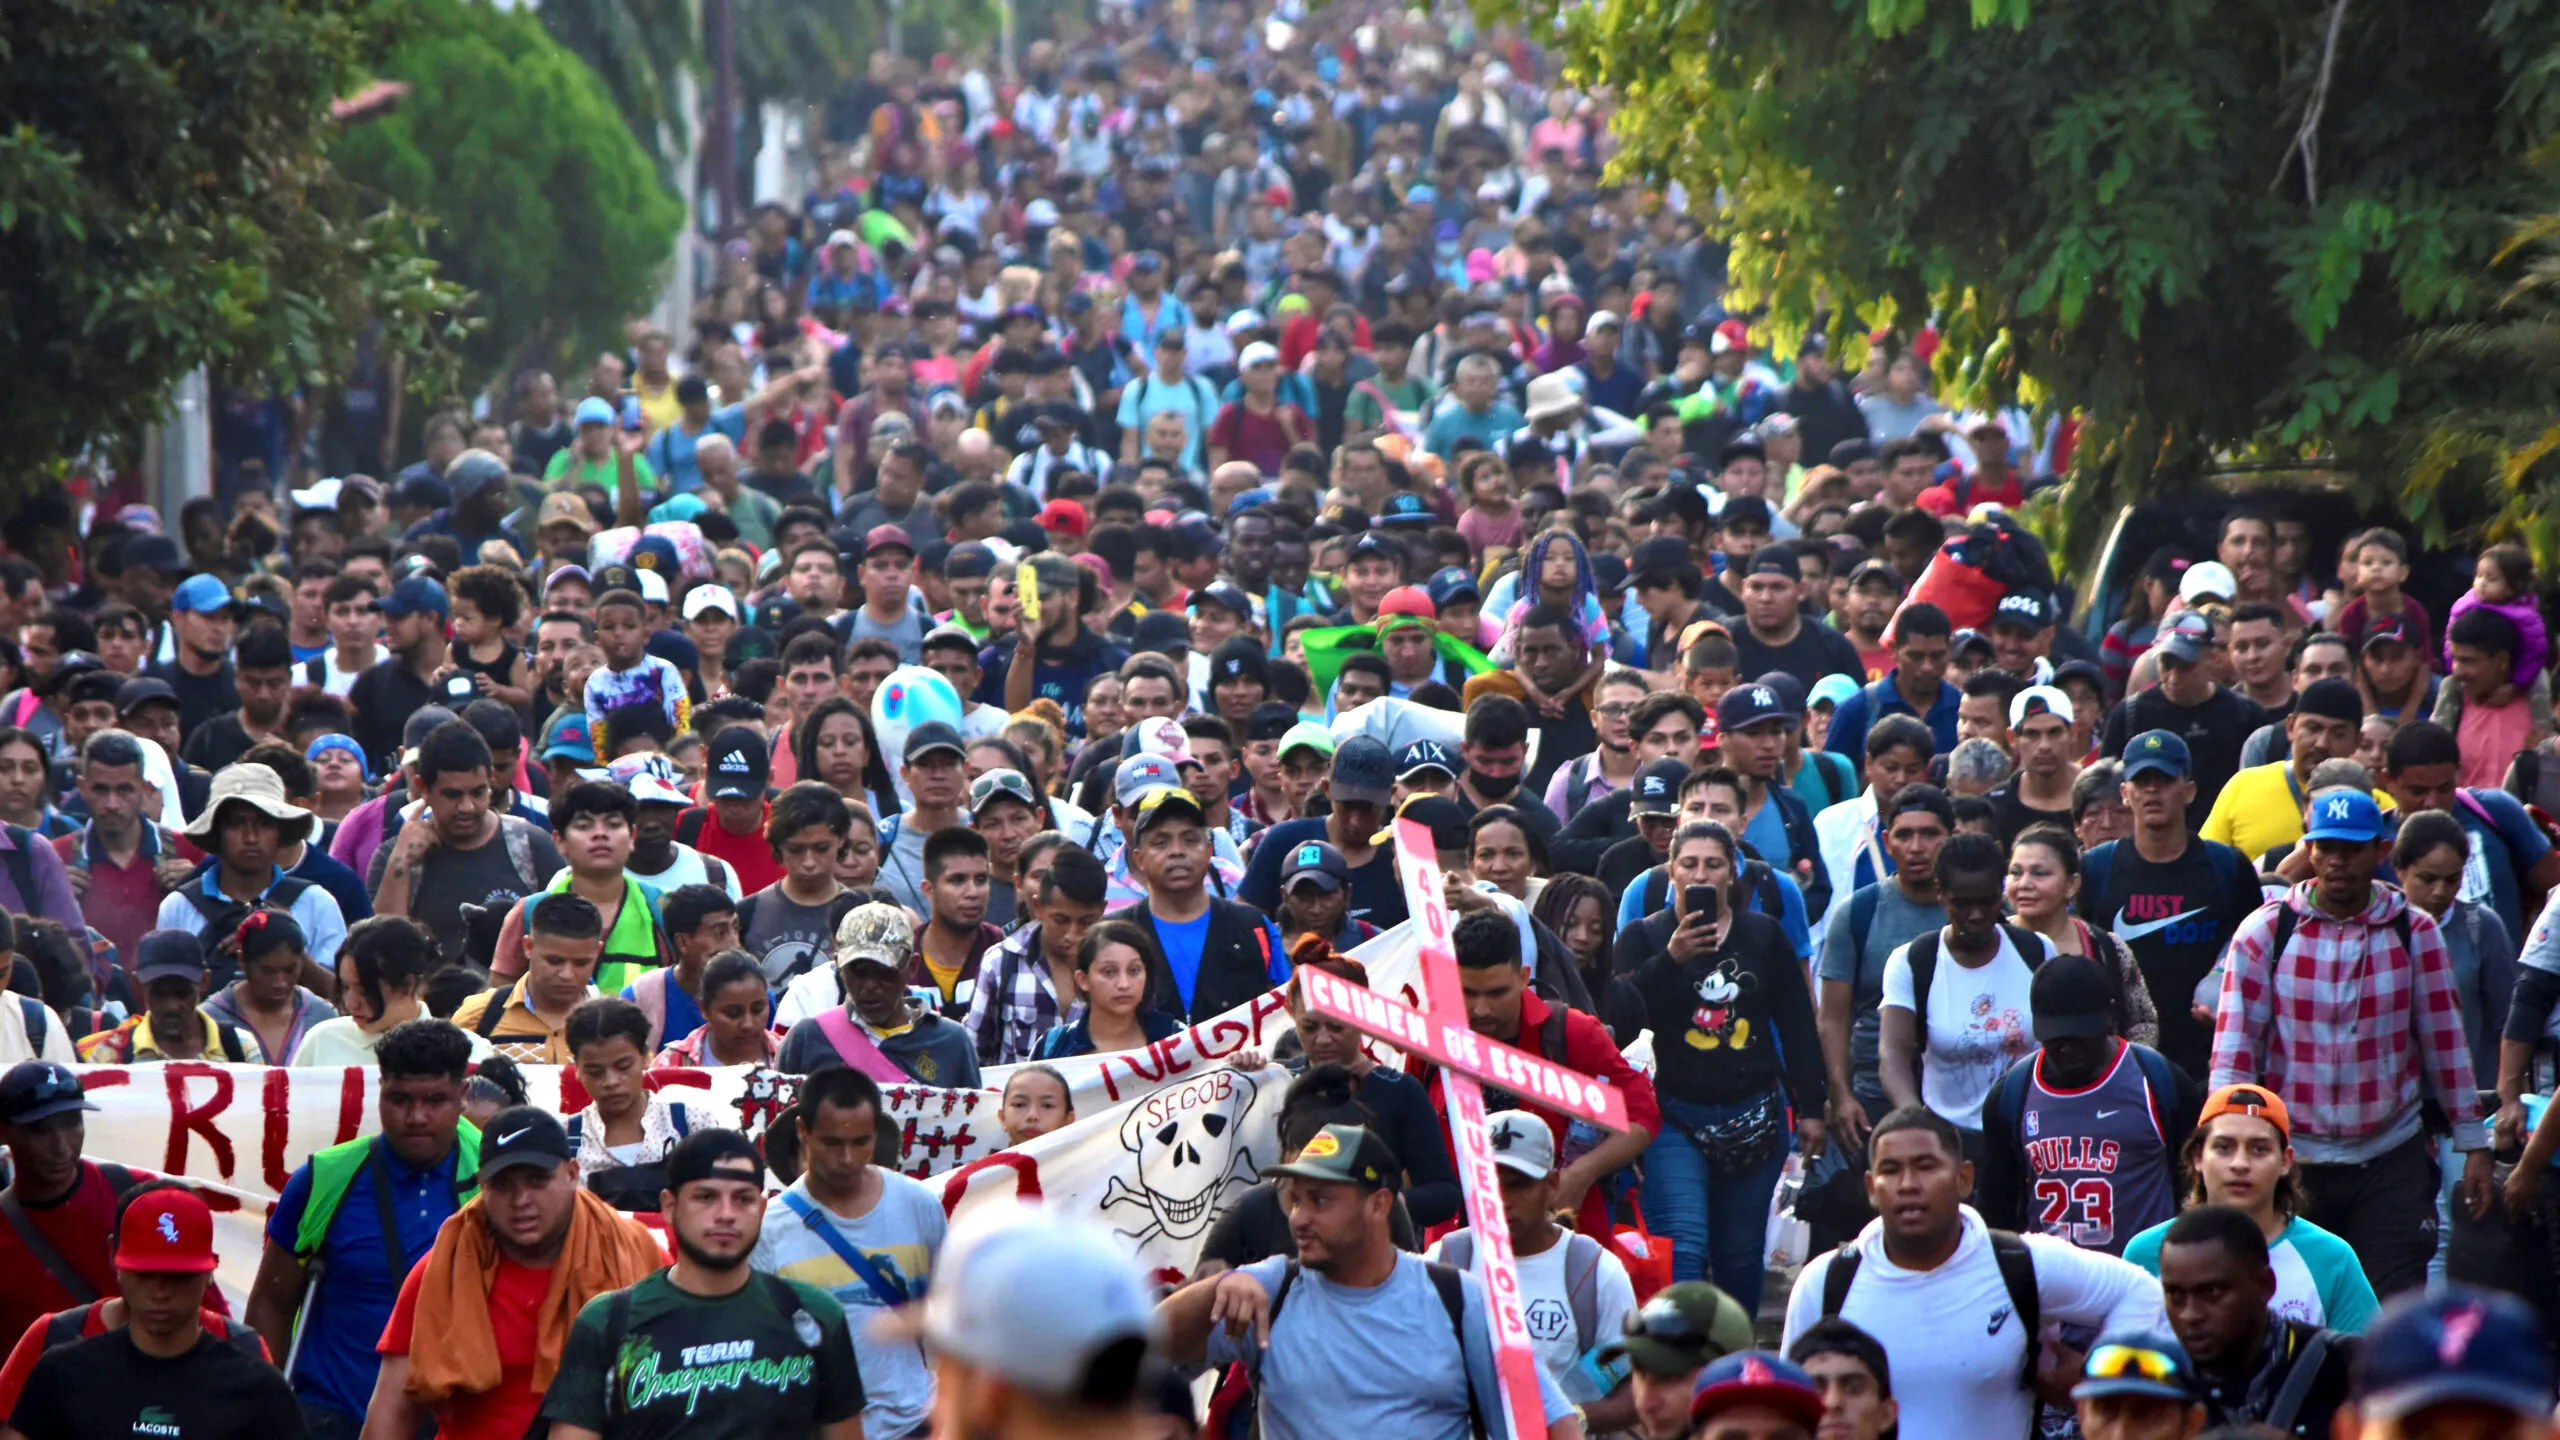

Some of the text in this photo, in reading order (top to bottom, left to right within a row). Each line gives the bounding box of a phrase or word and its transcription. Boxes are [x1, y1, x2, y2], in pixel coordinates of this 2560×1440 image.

[719, 763, 750, 772] adidas
[2327, 798, 2349, 820] NY
[2126, 894, 2184, 918] JUST
[2164, 921, 2198, 945] DO
[1311, 974, 1429, 1048] CRIMEN
[1442, 1025, 1481, 1068] DE
[1488, 1046, 1606, 1114] ESTADO
[1147, 1073, 1234, 1128] SEGOB
[2025, 1136, 2120, 1175] BULLS
[1458, 1093, 1522, 1333] MUERTOS
[2035, 1178, 2113, 1245] 23
[132, 1421, 180, 1437] LACOSTE
